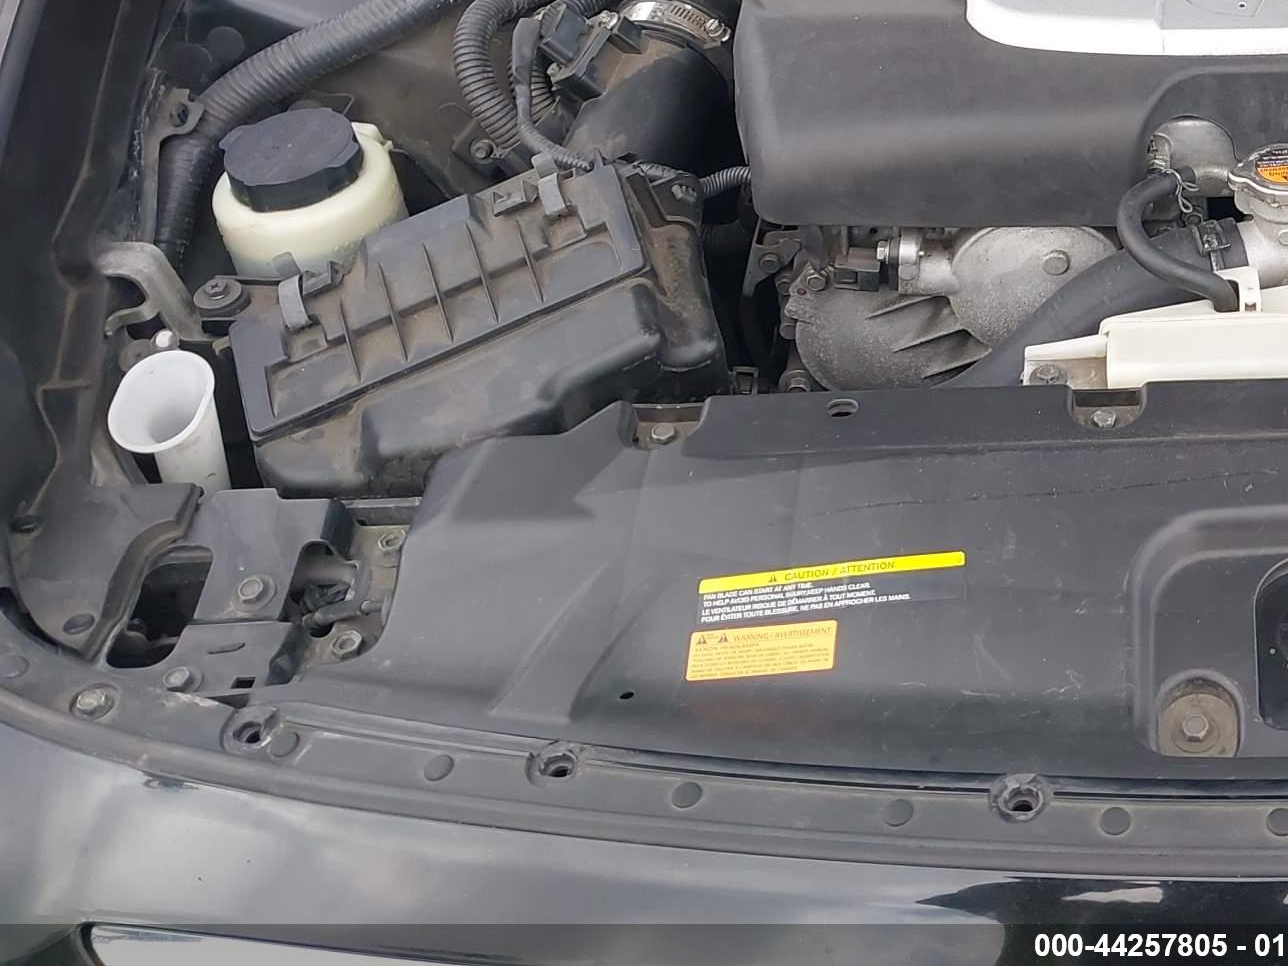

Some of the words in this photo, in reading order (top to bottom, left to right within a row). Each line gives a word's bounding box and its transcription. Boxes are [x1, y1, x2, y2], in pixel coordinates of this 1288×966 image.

[784, 568, 829, 581] CAUTION
[840, 560, 895, 574] ATTENTION
[824, 585, 847, 593] HANDS
[734, 631, 769, 643] WARNING
